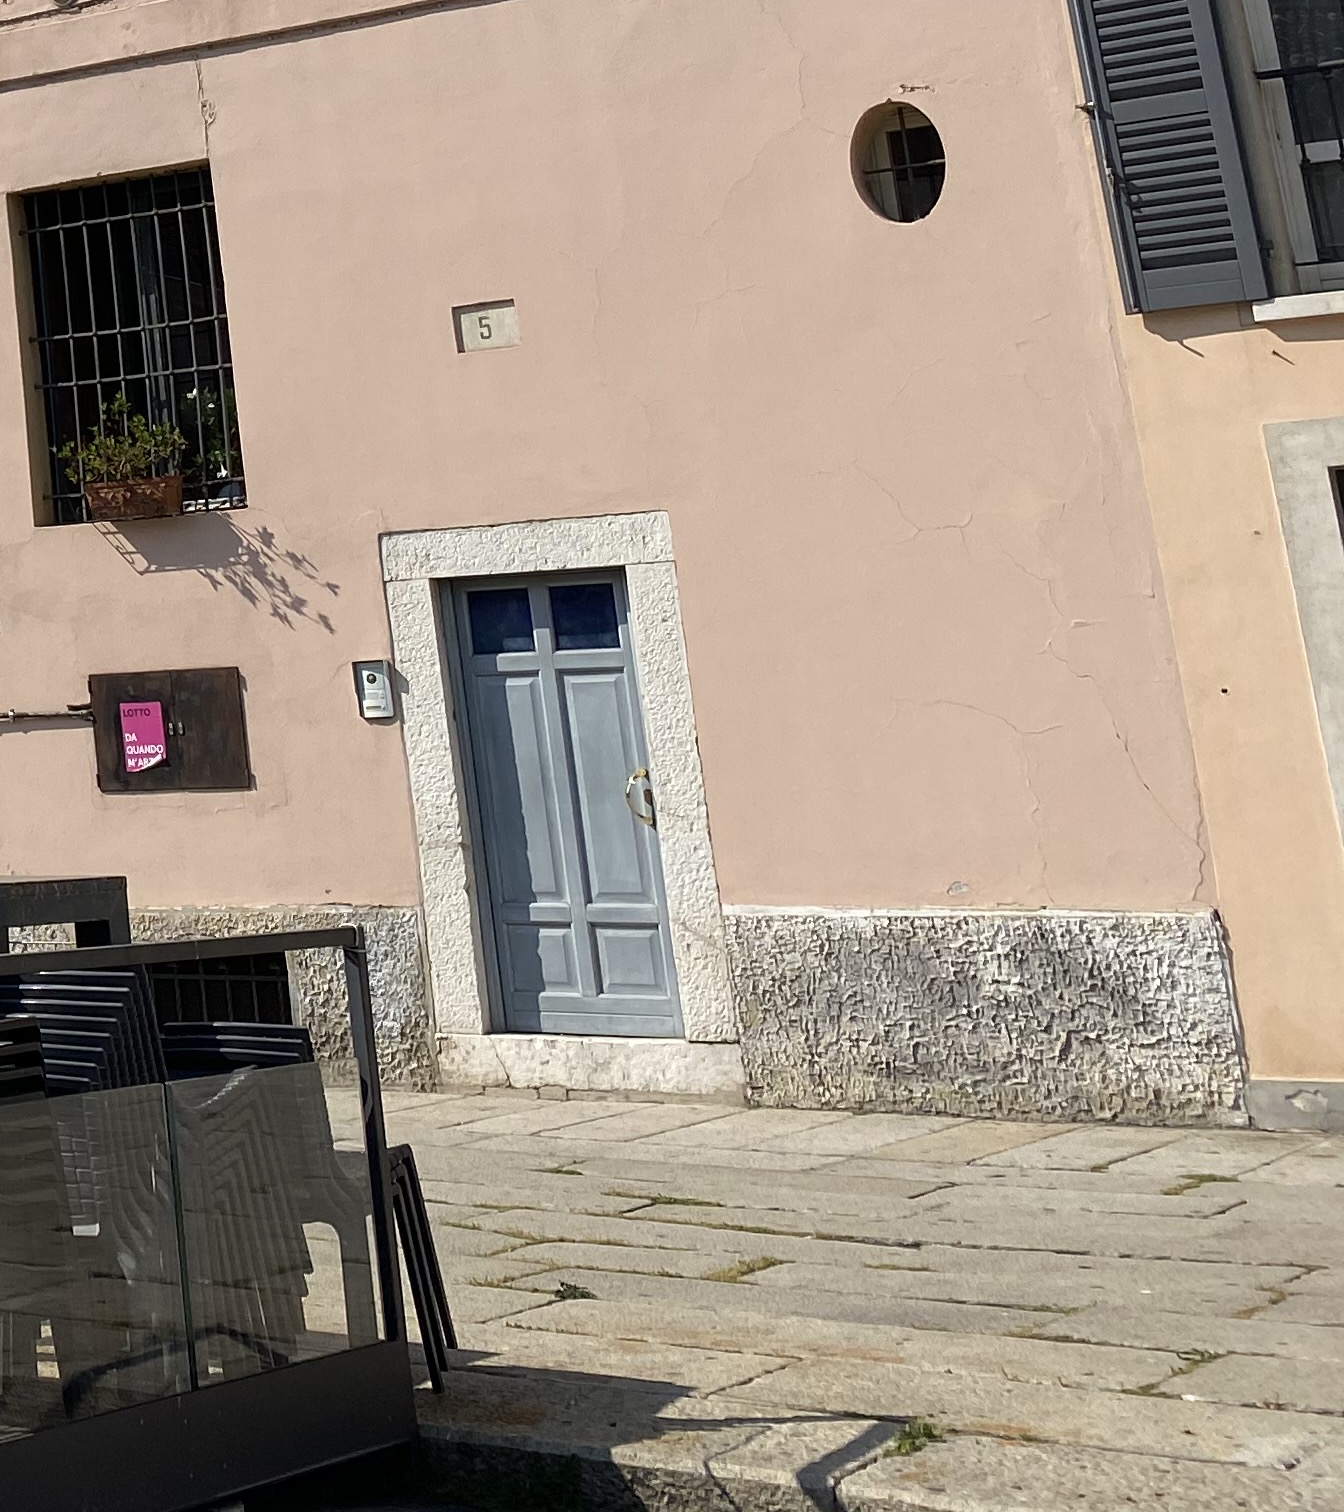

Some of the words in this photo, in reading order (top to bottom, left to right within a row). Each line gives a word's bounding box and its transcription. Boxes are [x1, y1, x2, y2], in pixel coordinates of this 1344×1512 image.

[478, 315, 492, 340] 5
[123, 708, 151, 717] LOTTO
[125, 733, 138, 742] DA
[126, 744, 163, 755] QUANDO
